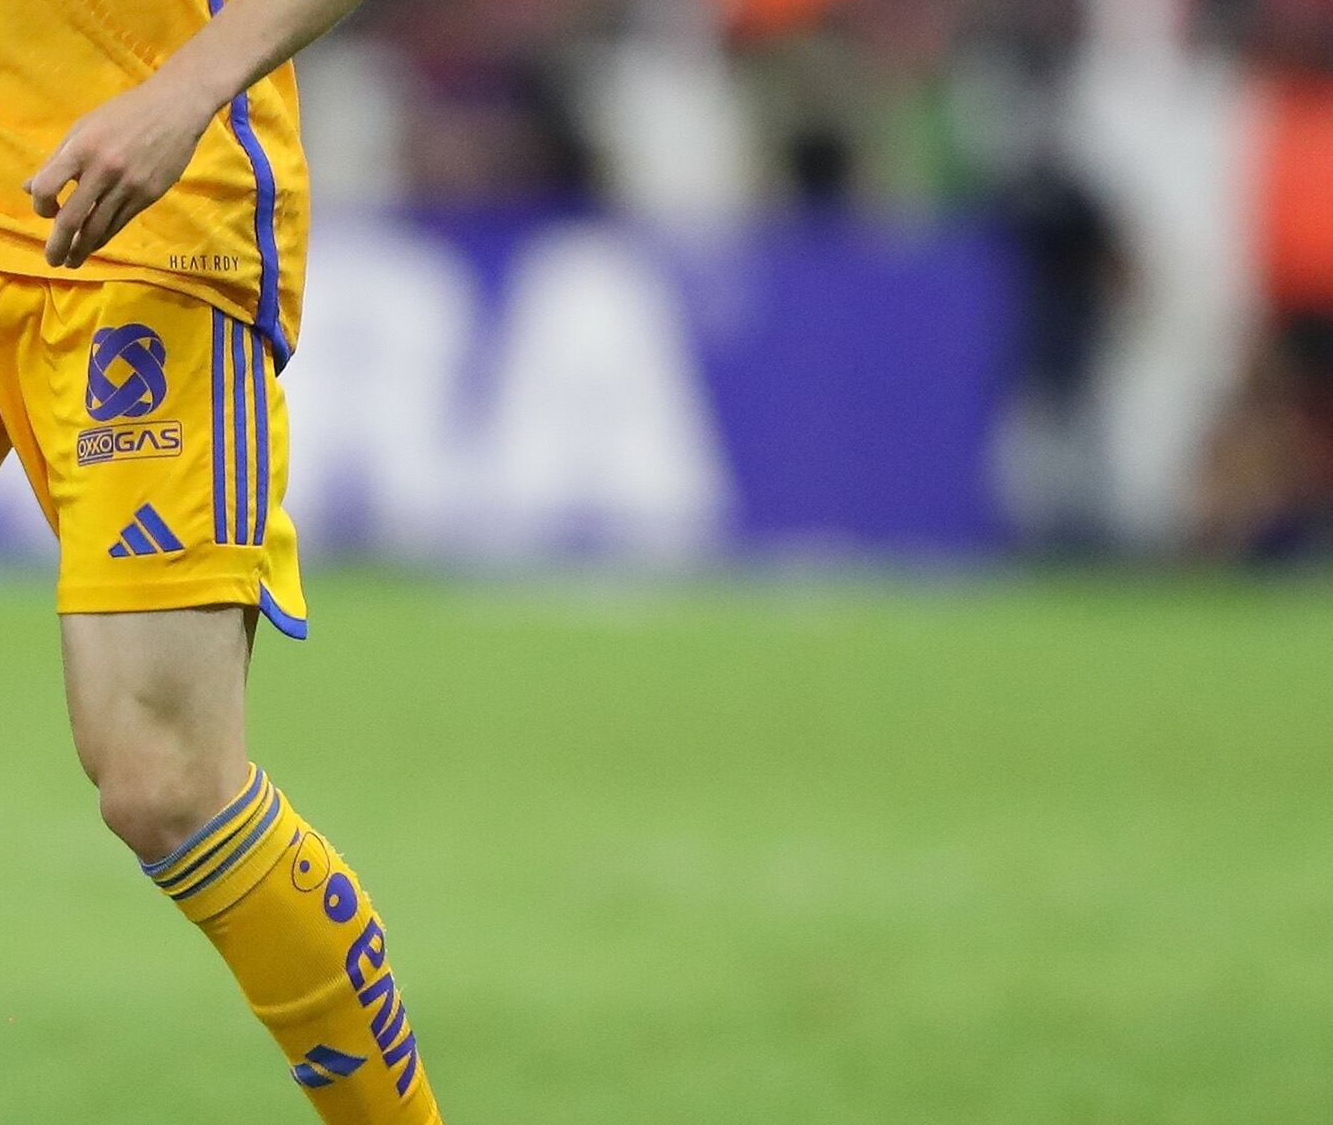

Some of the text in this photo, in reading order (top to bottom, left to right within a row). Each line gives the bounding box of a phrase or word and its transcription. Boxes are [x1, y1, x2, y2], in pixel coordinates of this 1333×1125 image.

[169, 255, 240, 271] HEAT.RDY
[78, 428, 181, 458] OXXO GAS
